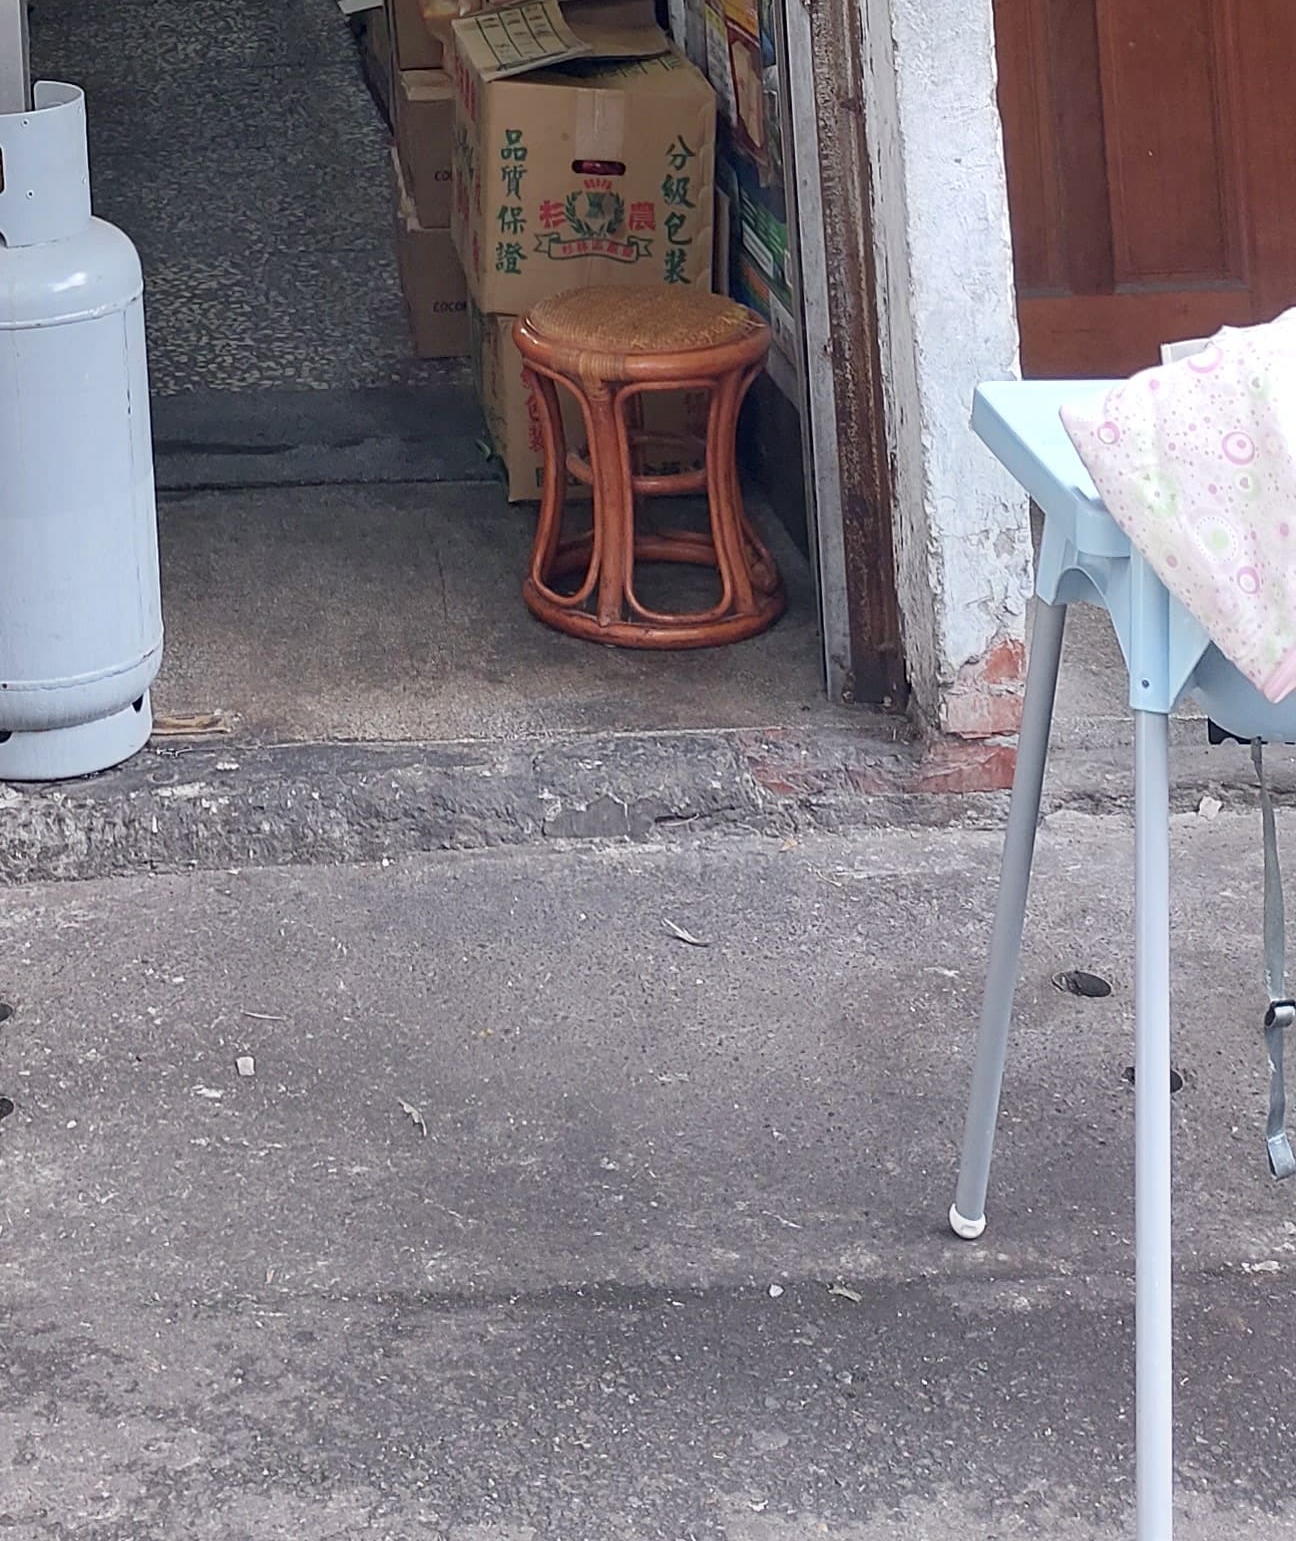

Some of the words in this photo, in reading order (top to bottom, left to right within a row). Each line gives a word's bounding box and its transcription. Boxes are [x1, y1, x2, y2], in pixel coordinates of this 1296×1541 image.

[495, 129, 528, 276] 品質保證
[661, 134, 697, 286] 分級包裝
